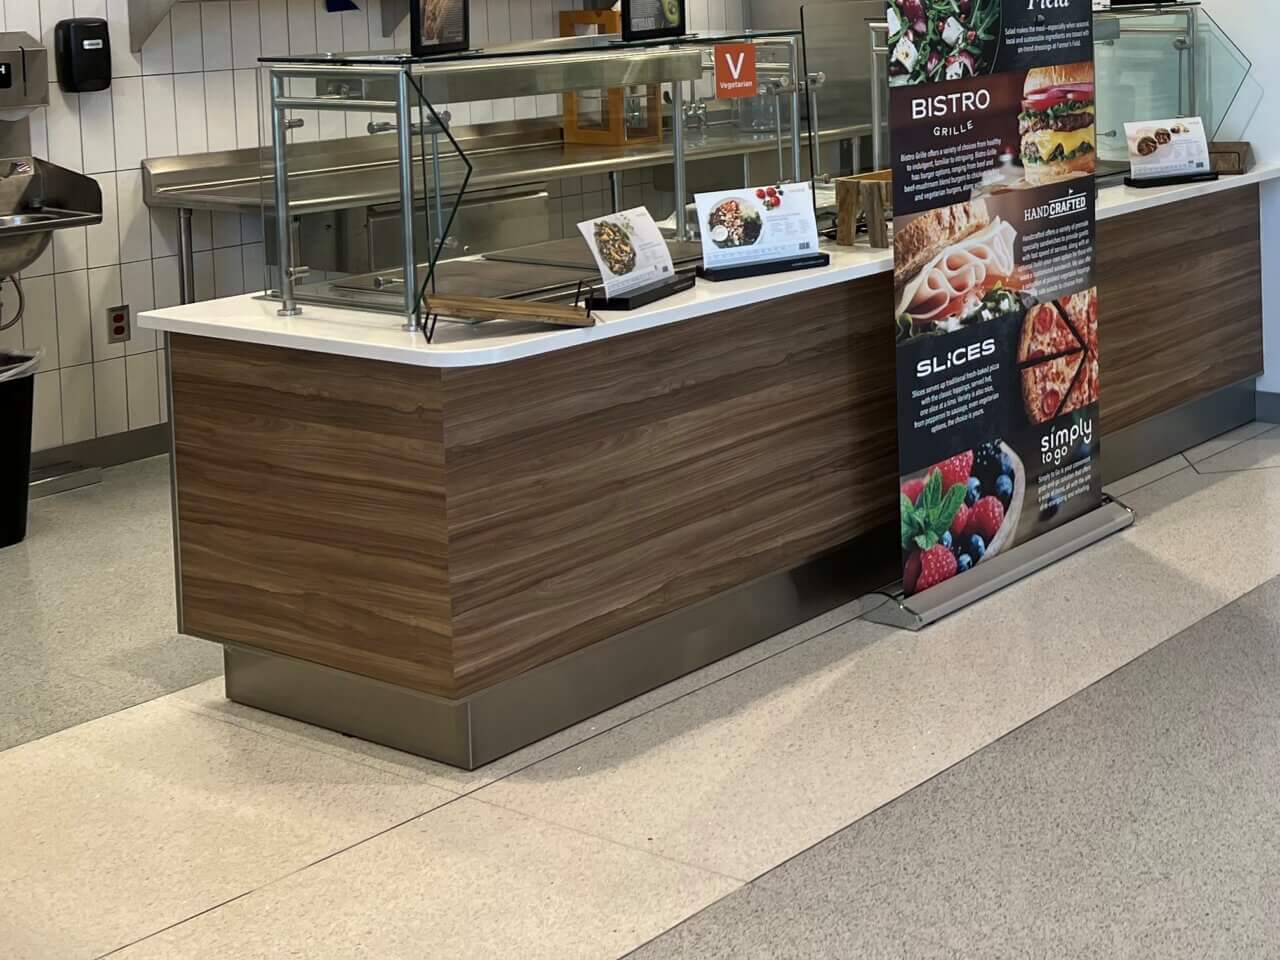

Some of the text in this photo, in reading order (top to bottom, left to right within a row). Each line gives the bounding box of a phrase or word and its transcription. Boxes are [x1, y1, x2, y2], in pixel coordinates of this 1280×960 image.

[725, 52, 745, 80] V
[912, 89, 990, 119] BISTRO
[933, 120, 974, 136] GRILLE
[1024, 196, 1086, 221] HANDCRAFTED
[1041, 418, 1092, 452] simply
[1042, 446, 1068, 465] to go
